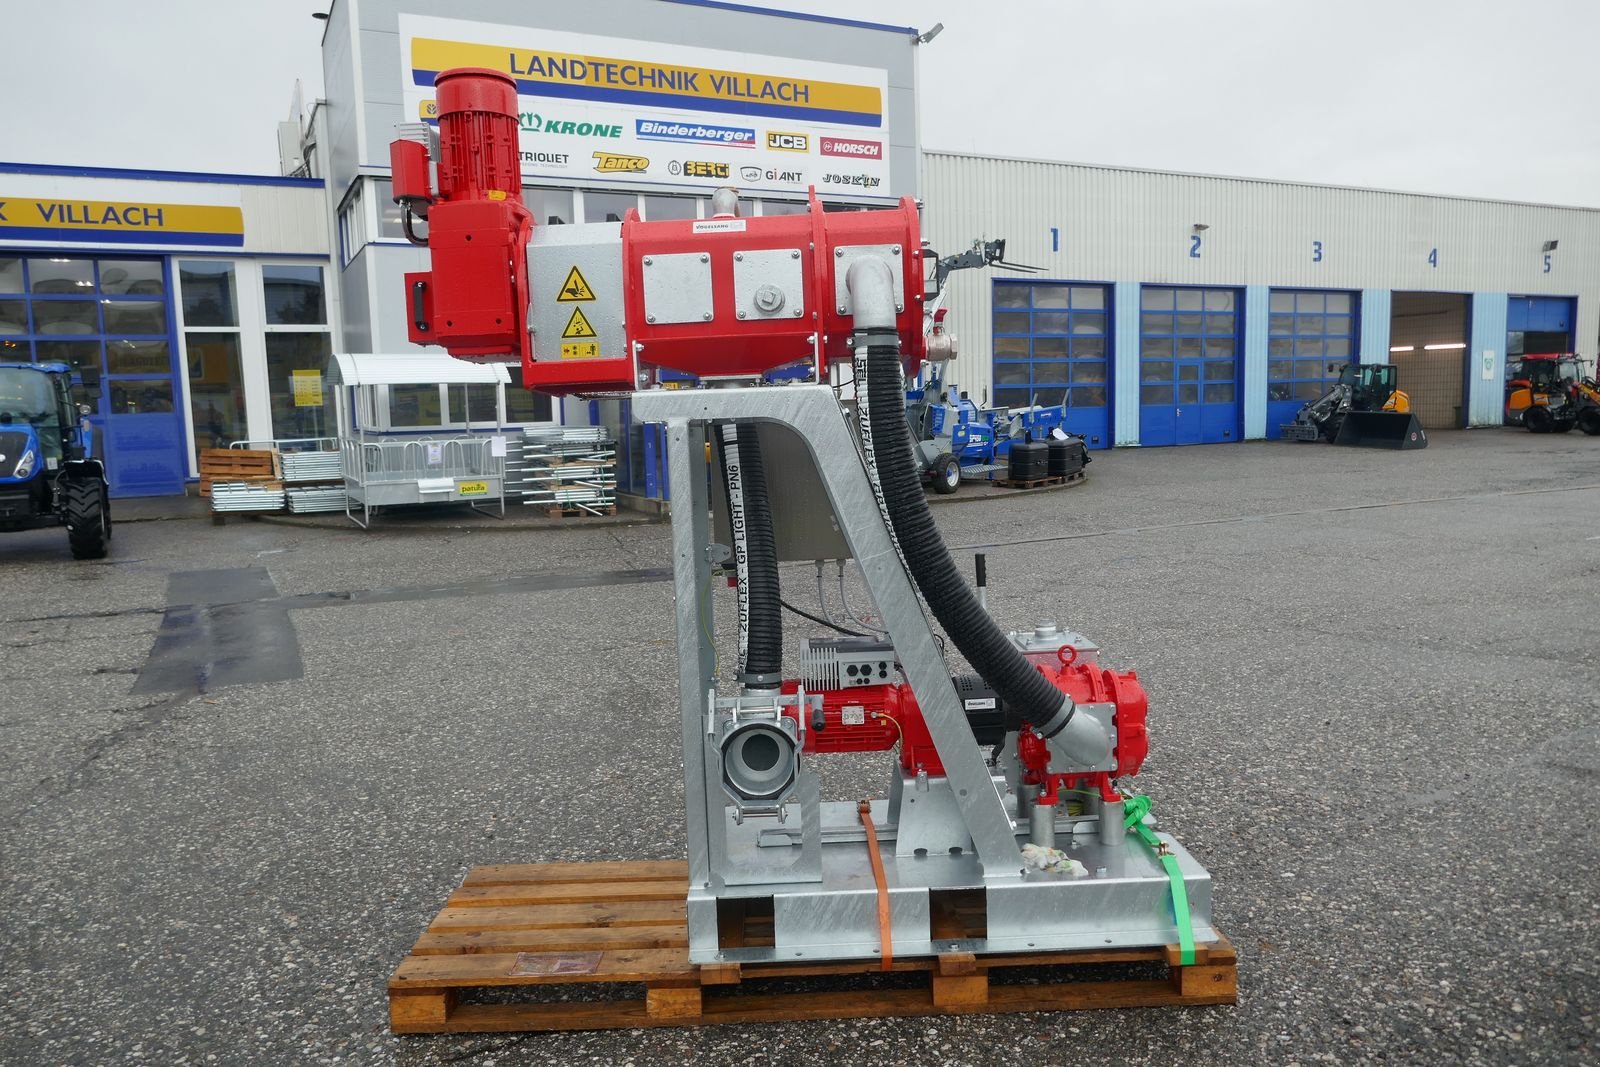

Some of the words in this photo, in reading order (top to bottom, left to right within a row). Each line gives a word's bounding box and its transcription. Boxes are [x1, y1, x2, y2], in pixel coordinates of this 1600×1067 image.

[510, 53, 699, 92] LANDTECHNIK
[709, 74, 809, 103] VILLACH
[544, 120, 623, 138] KRONE
[640, 121, 752, 142] Binderberger
[769, 134, 807, 149] JCB
[833, 142, 879, 156] HORSCH
[518, 151, 569, 164] TRIOLIET
[592, 151, 650, 172] Tanco
[822, 173, 881, 188] JOSKIN
[36, 202, 164, 226] VILLACH
[1050, 228, 1059, 252] 1
[1190, 235, 1201, 258] 2
[1312, 241, 1323, 262] 3
[1428, 248, 1438, 268] 4
[1543, 255, 1552, 274] 5
[727, 464, 741, 490] PN6
[731, 502, 746, 542] LIGHT
[736, 545, 747, 565] GP
[739, 576, 748, 632] ZUFLEX
